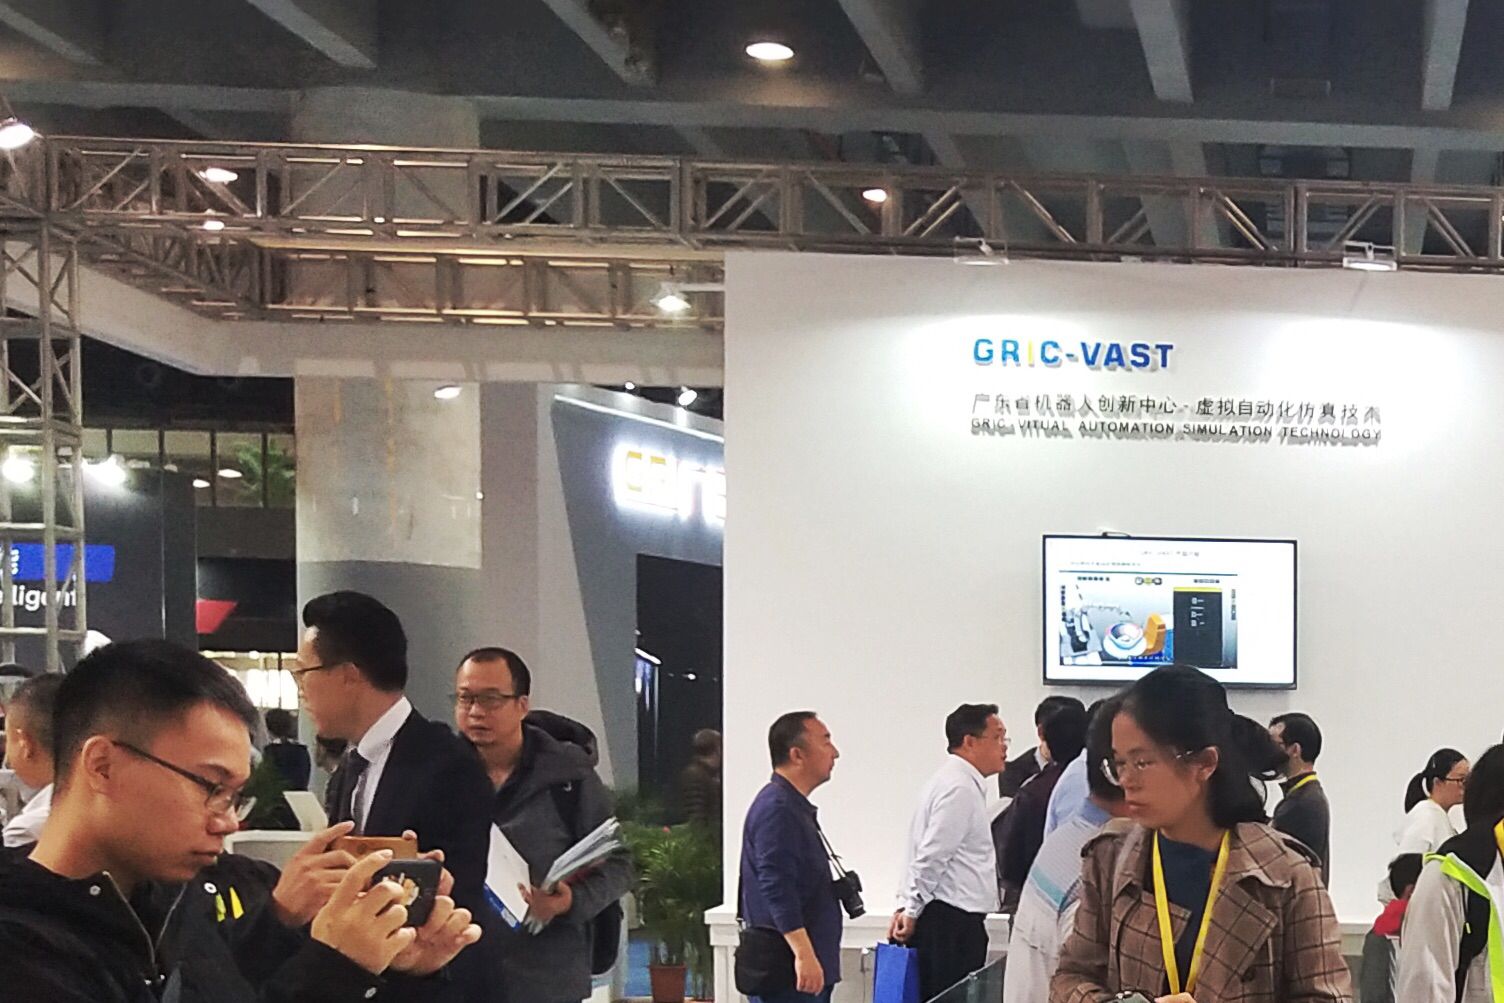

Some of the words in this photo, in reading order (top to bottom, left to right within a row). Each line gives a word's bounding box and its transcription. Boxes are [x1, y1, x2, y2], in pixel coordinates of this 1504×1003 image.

[973, 338, 1174, 369] GRIC-VAST
[1078, 420, 1175, 435] AUTOMATION
[1182, 422, 1273, 438] SIMULATION
[1281, 425, 1382, 441] TECHNOLOGY
